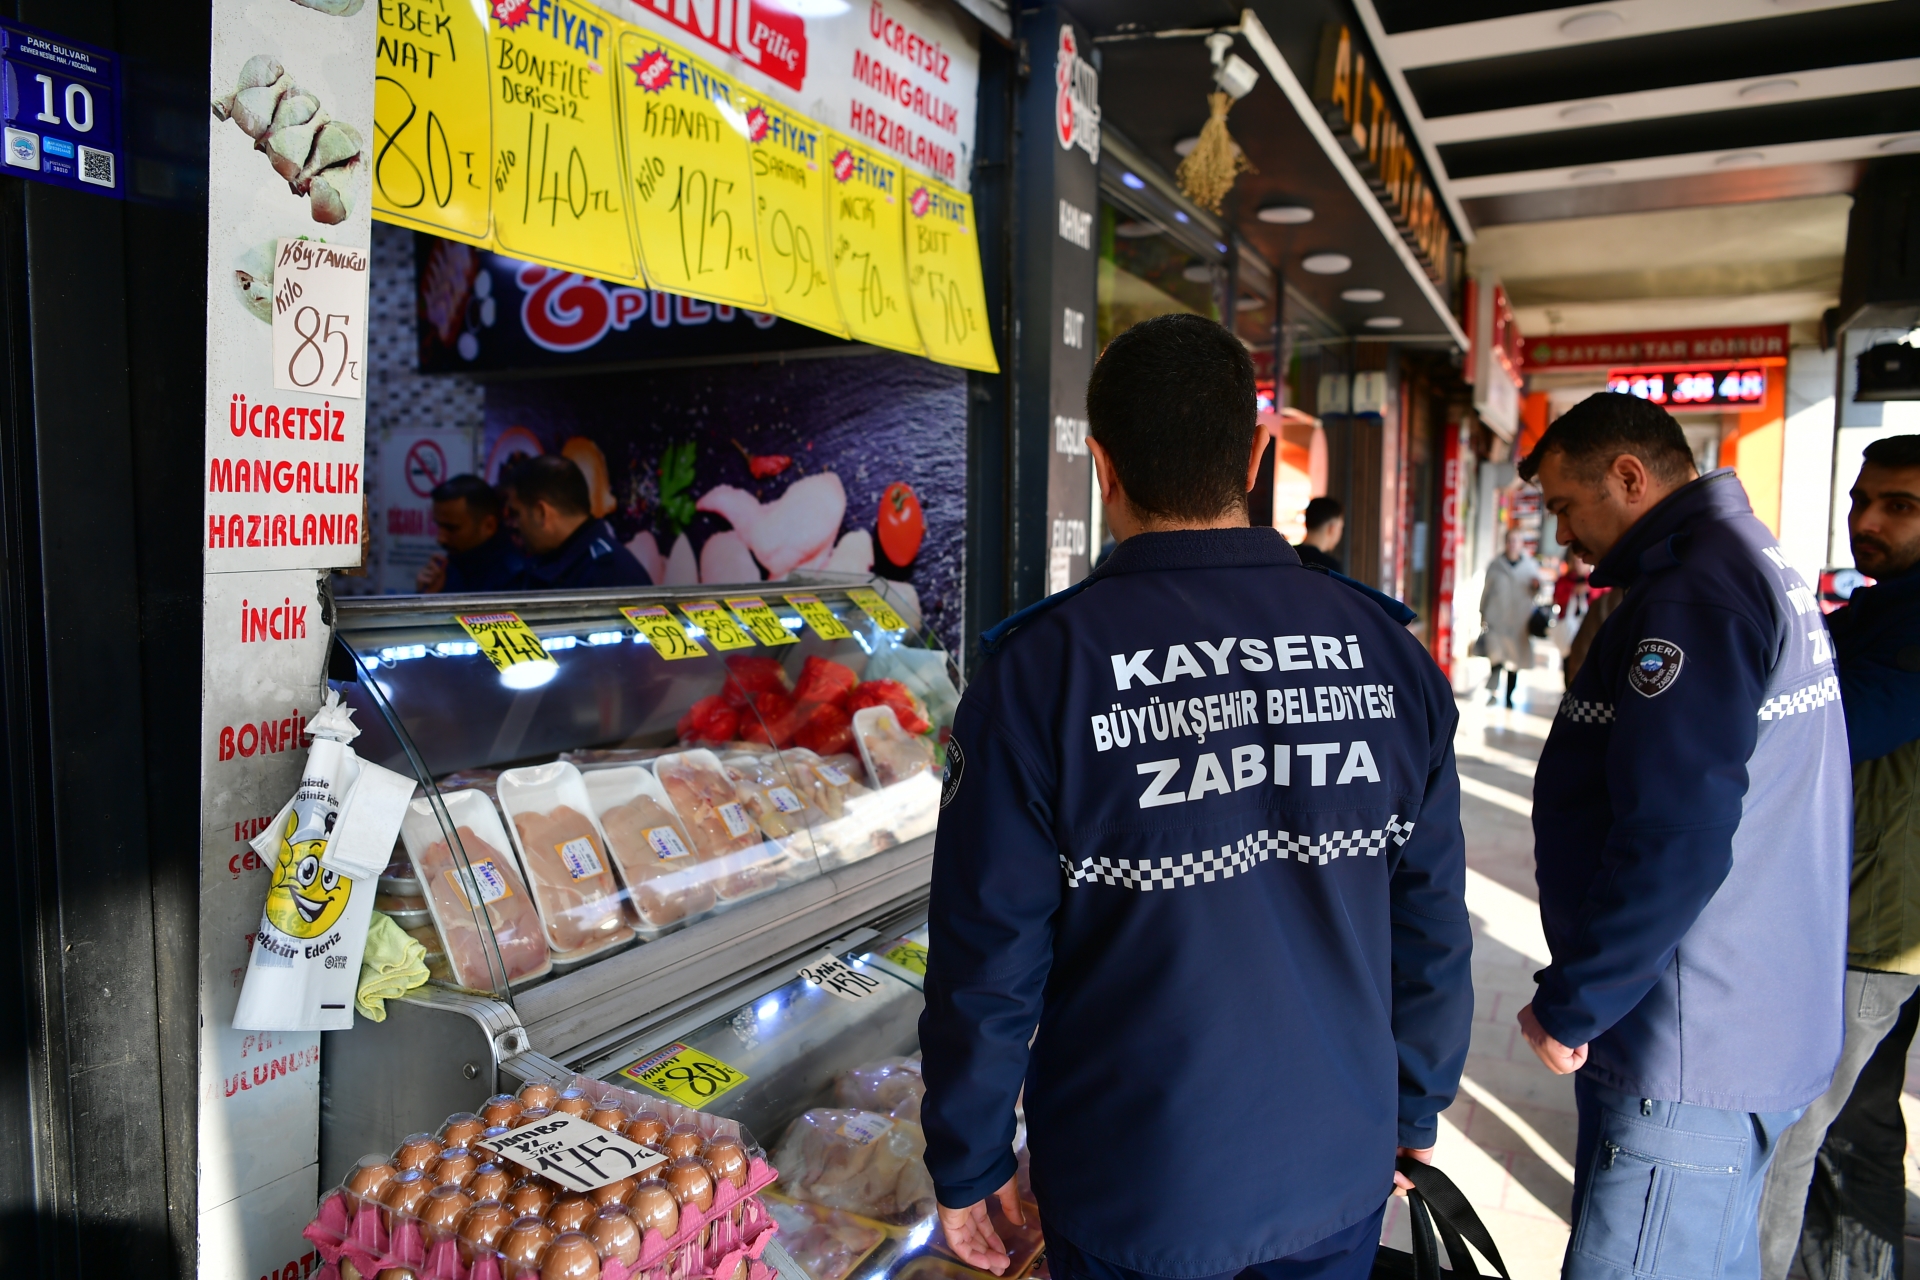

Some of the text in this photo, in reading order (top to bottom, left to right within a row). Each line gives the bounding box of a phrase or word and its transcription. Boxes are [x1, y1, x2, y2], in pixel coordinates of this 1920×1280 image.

[27, 36, 90, 63] PARK BULVARI
[538, 0, 604, 60] FİYAT
[752, 20, 800, 72] Piliç
[869, 0, 951, 84] ÜCRETSİZ
[35, 73, 94, 133] 10
[852, 48, 958, 136] MANGALLIK
[374, 75, 453, 209] 80
[643, 101, 723, 144] KANAT
[772, 112, 817, 161] FİYAT
[850, 98, 957, 181] HAZIRLANIR
[523, 111, 589, 227] 140
[668, 165, 735, 282] 125
[288, 305, 350, 388] 85
[230, 393, 345, 442] ÜCRETSİZ
[209, 457, 360, 494] MANGALLIK
[208, 513, 359, 549] HAZIRLANIR
[241, 597, 307, 643] İNCİK
[1110, 634, 1365, 691] KAYSERİ
[1635, 644, 1678, 657] AYSERİ
[218, 708, 316, 762] BONFİL
[1091, 684, 1396, 752] BÜYÜKŞEHİR BELEDİYESİ
[1136, 740, 1381, 809] ZABITA
[326, 793, 340, 808] için
[234, 814, 278, 842] KIY
[256, 930, 299, 959] ekkür
[304, 932, 342, 960] Ederiz
[333, 962, 347, 970] ATIK
[334, 955, 348, 963] SIFIR
[826, 970, 880, 998] 150
[641, 1055, 681, 1081] KANAT
[664, 1062, 732, 1097] 80
[536, 1134, 637, 1188] 175
